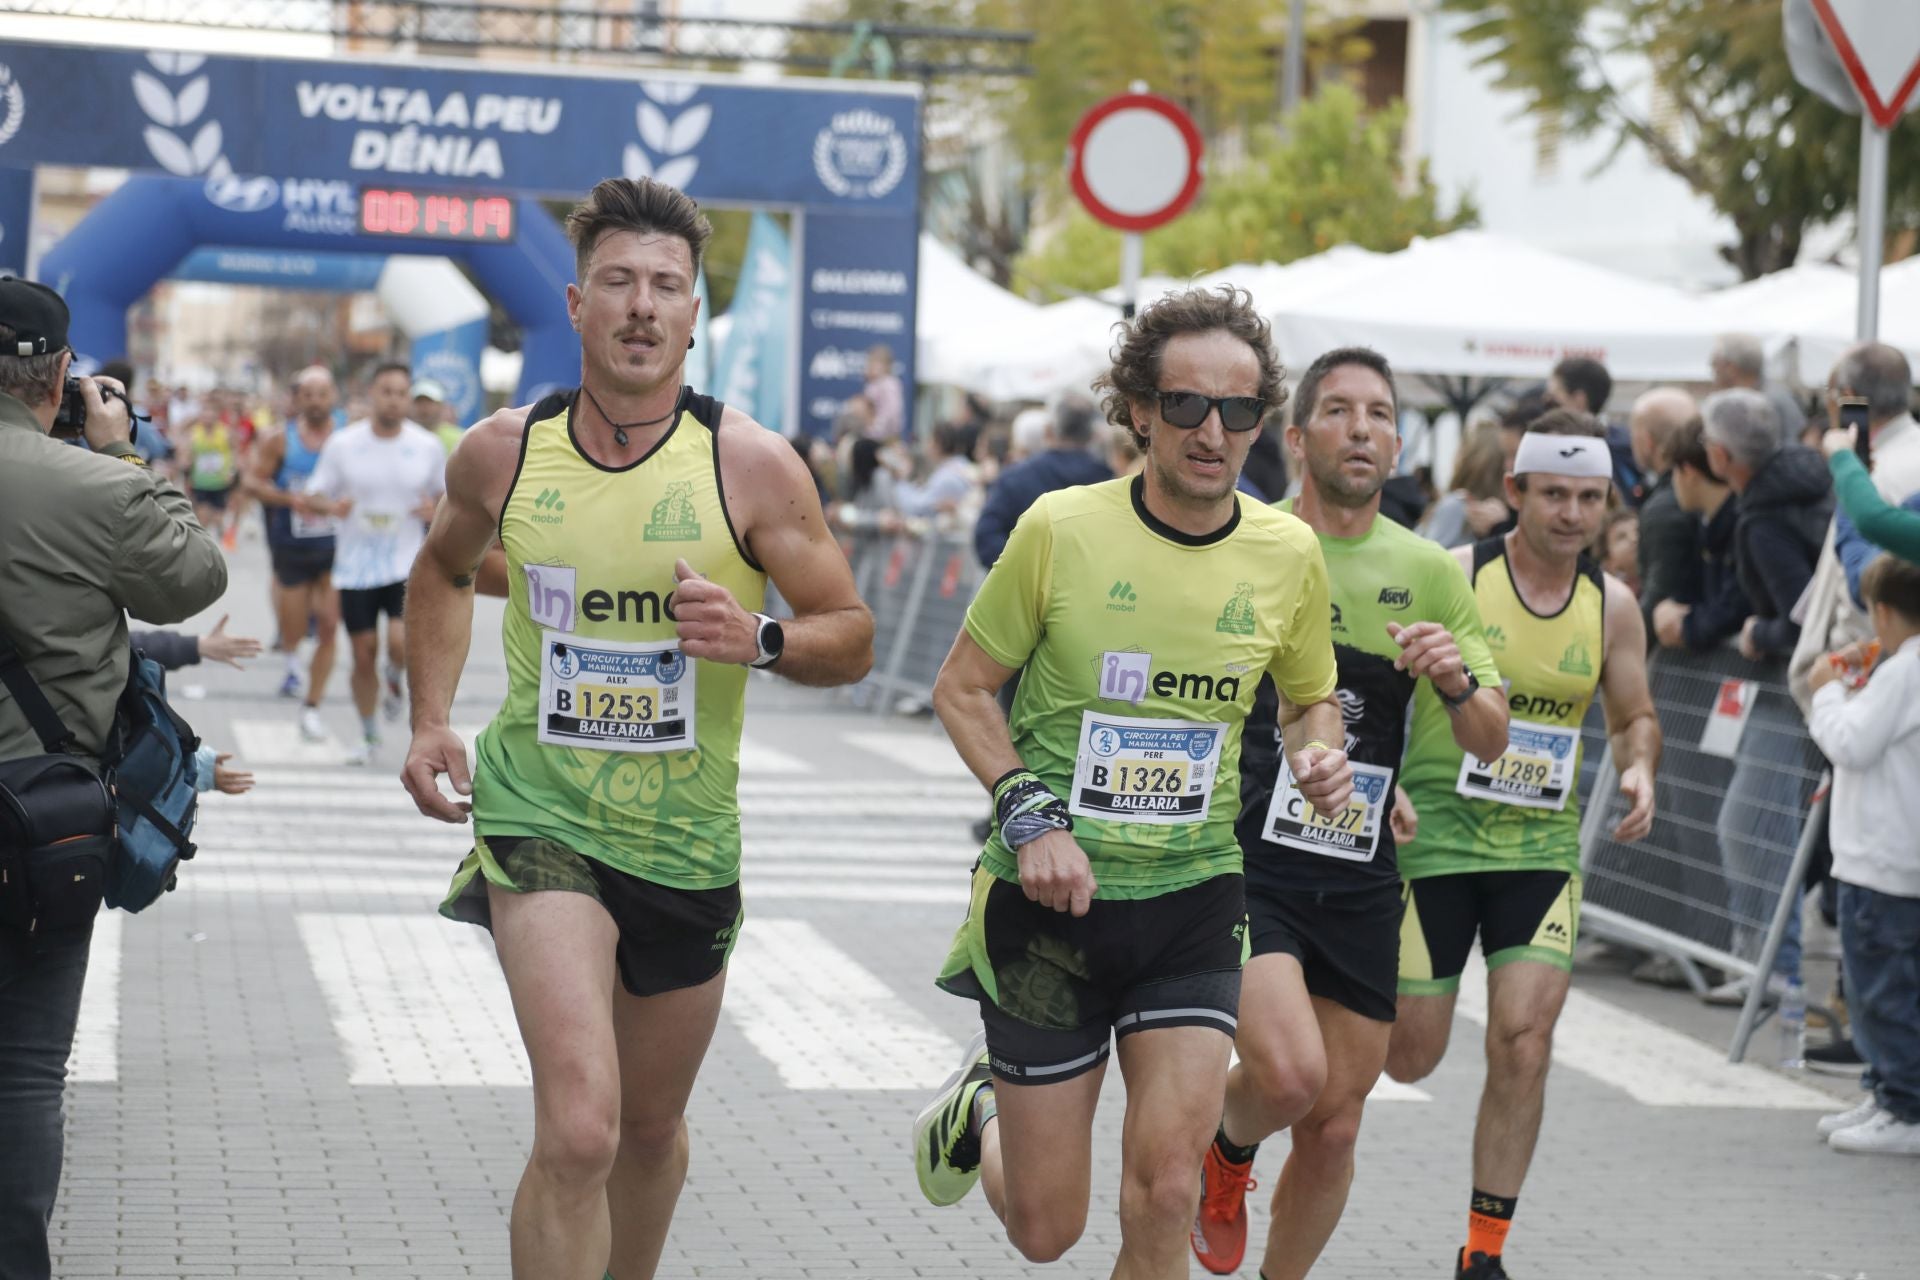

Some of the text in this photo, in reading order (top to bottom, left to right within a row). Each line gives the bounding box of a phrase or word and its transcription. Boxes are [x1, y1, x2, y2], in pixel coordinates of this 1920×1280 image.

[296, 81, 563, 134] VOLTA A PEU
[350, 124, 504, 179] DÉNIA
[531, 514, 563, 525] mobel
[1378, 587, 1410, 604] Asevi
[1106, 602, 1136, 612] mobel
[582, 653, 652, 665] CIRCUIT A PEU
[588, 663, 621, 672] MARINA
[606, 675, 628, 684] ALEX
[557, 689, 653, 721] B 1253
[1123, 731, 1160, 740] CIRCUIT
[1169, 733, 1188, 741] PEU
[1143, 751, 1164, 759] PERE
[1498, 757, 1548, 784] 1289
[1091, 765, 1182, 793] B 1326
[1287, 797, 1303, 818] C
